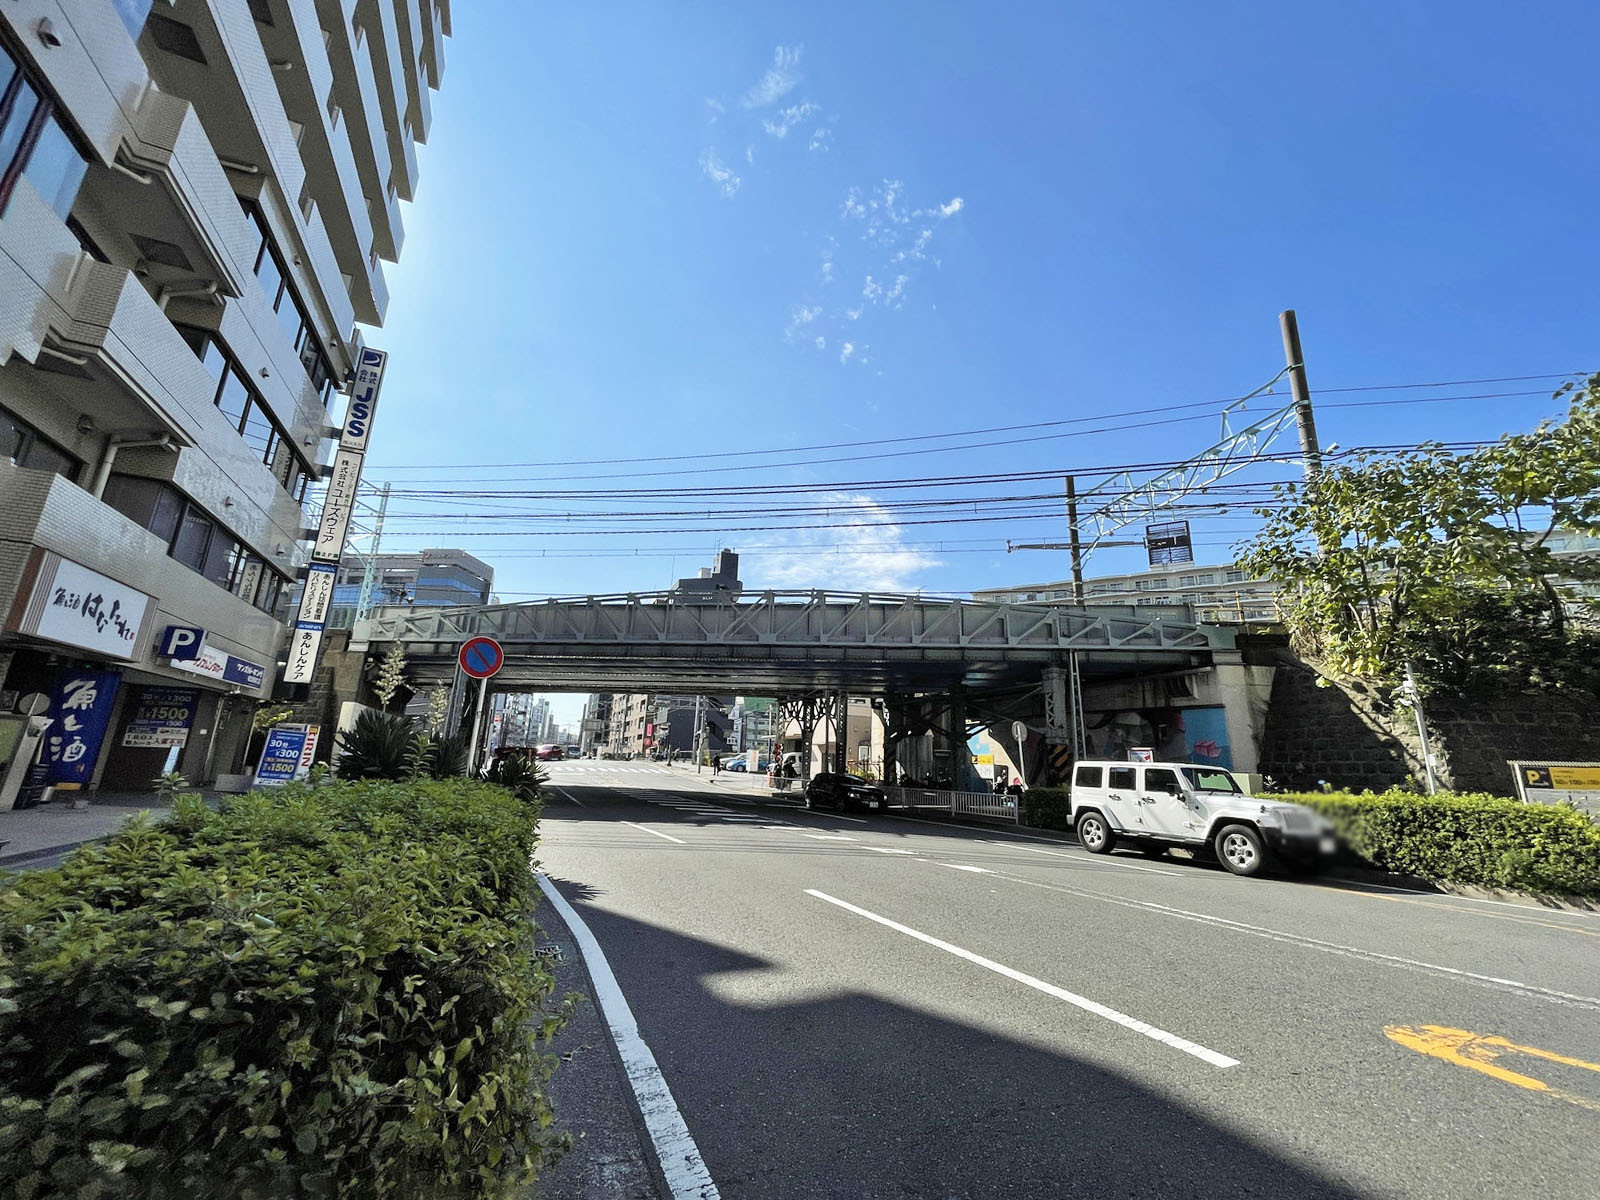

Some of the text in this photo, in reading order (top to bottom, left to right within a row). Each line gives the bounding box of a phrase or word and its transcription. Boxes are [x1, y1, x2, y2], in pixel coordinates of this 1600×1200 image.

[347, 387, 374, 437] JSS
[167, 629, 195, 655] P
[293, 632, 313, 680] あんしんケア
[50, 678, 97, 762] 魚と酒
[1525, 769, 1541, 786] P
